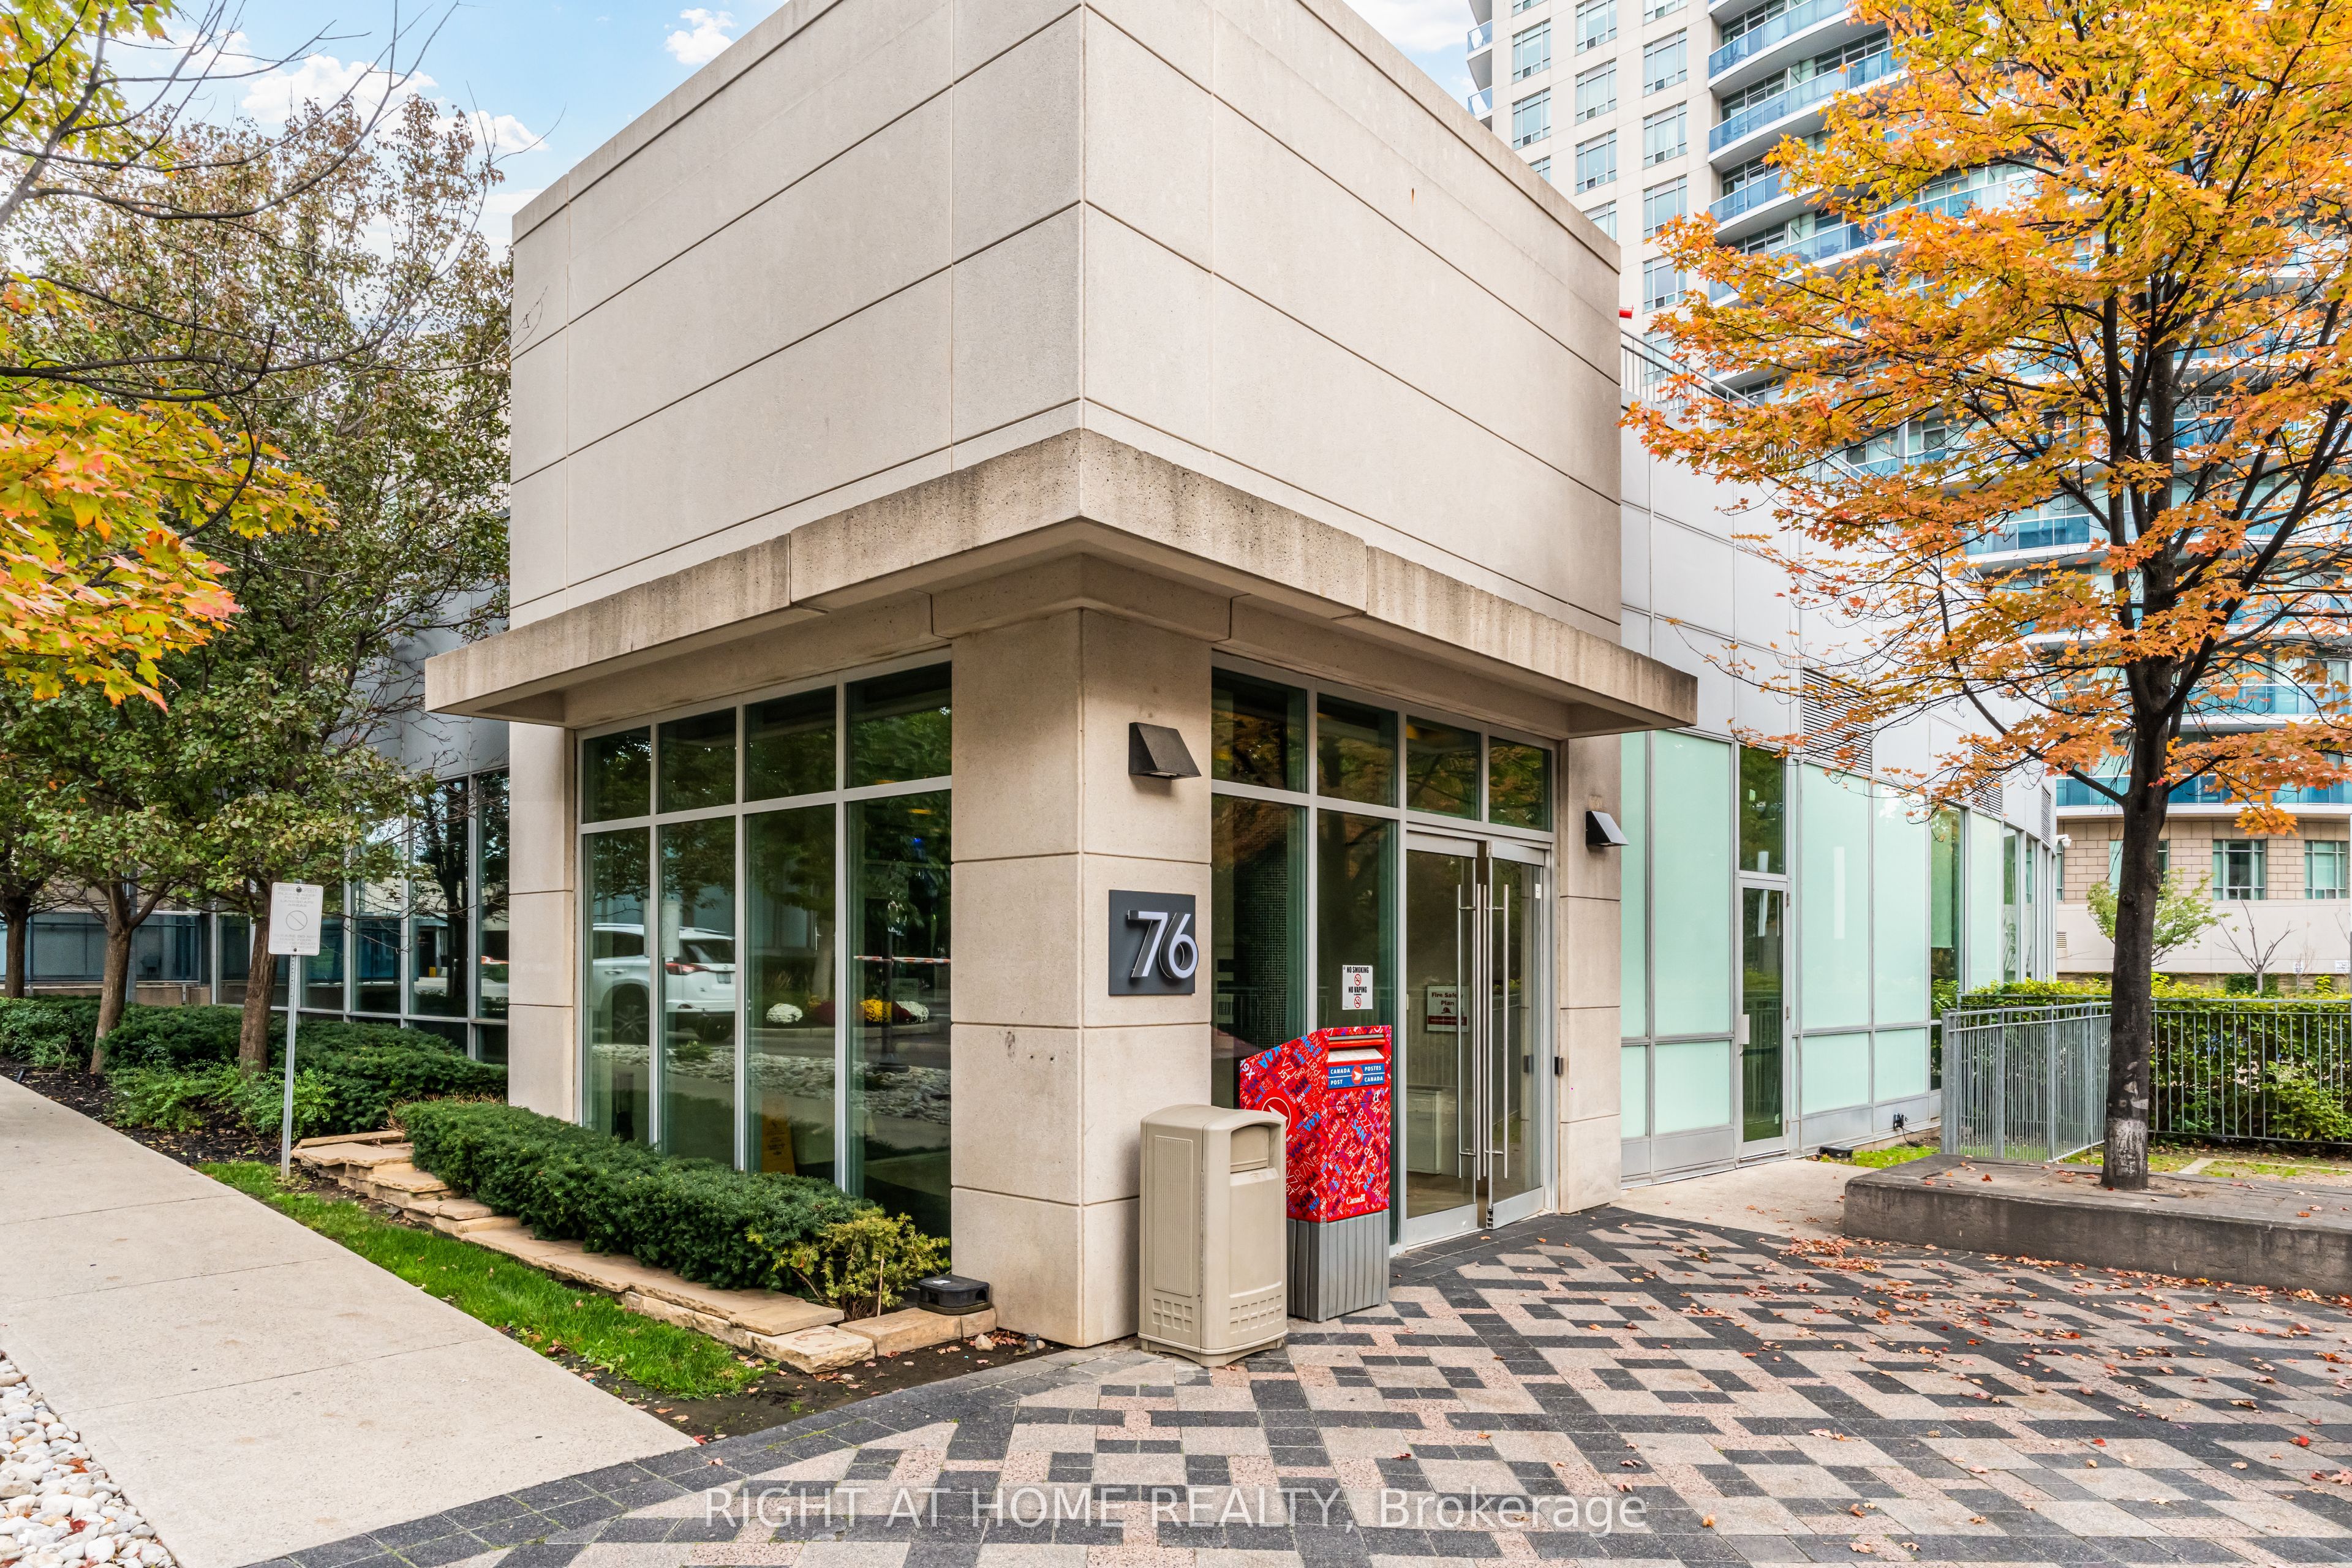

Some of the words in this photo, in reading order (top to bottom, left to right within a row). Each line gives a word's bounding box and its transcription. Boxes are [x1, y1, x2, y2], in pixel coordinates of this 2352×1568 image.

[1128, 910, 1199, 979] 76
[1303, 1112, 1321, 1131] K4A
[1357, 1108, 1372, 1133] B2Z
[1347, 1163, 1365, 1193] T9K
